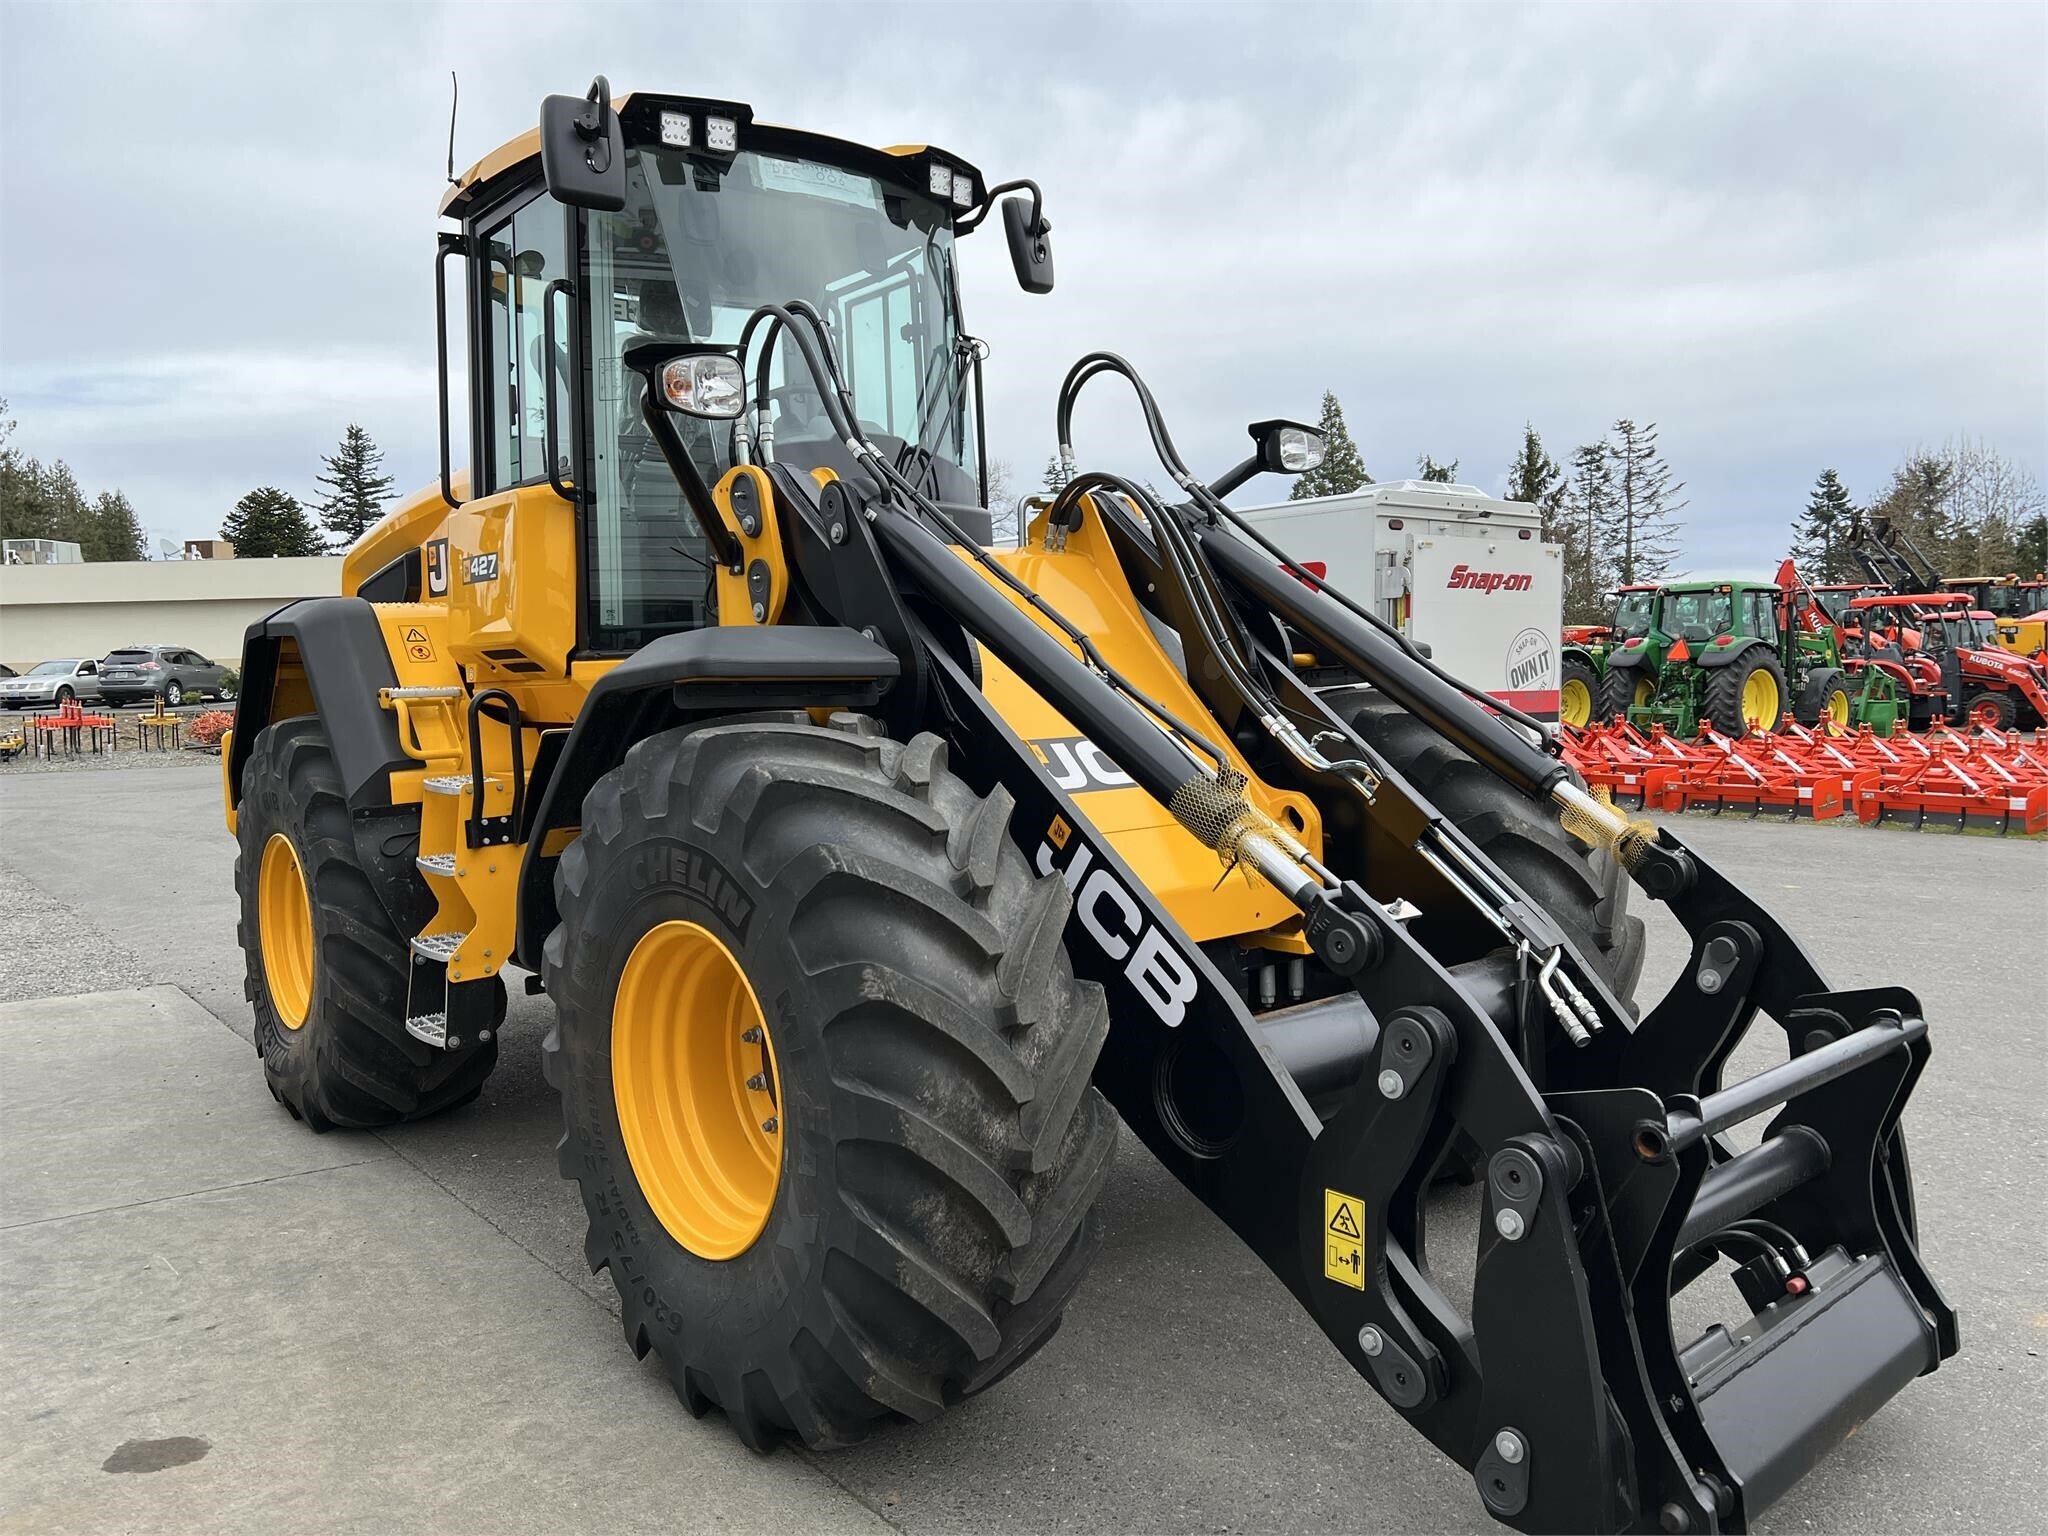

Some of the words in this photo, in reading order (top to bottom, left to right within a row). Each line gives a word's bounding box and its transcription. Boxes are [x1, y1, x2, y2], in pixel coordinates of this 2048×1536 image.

[470, 554, 497, 576] 427
[1447, 564, 1533, 595] Snap-on
[1510, 656, 1539, 690] OWN
[1538, 649, 1550, 674] IT
[1969, 654, 2005, 671] KUBOTA
[1046, 740, 1137, 790] JC
[628, 846, 753, 930] CHELIN
[1036, 840, 1199, 1029] JCB
